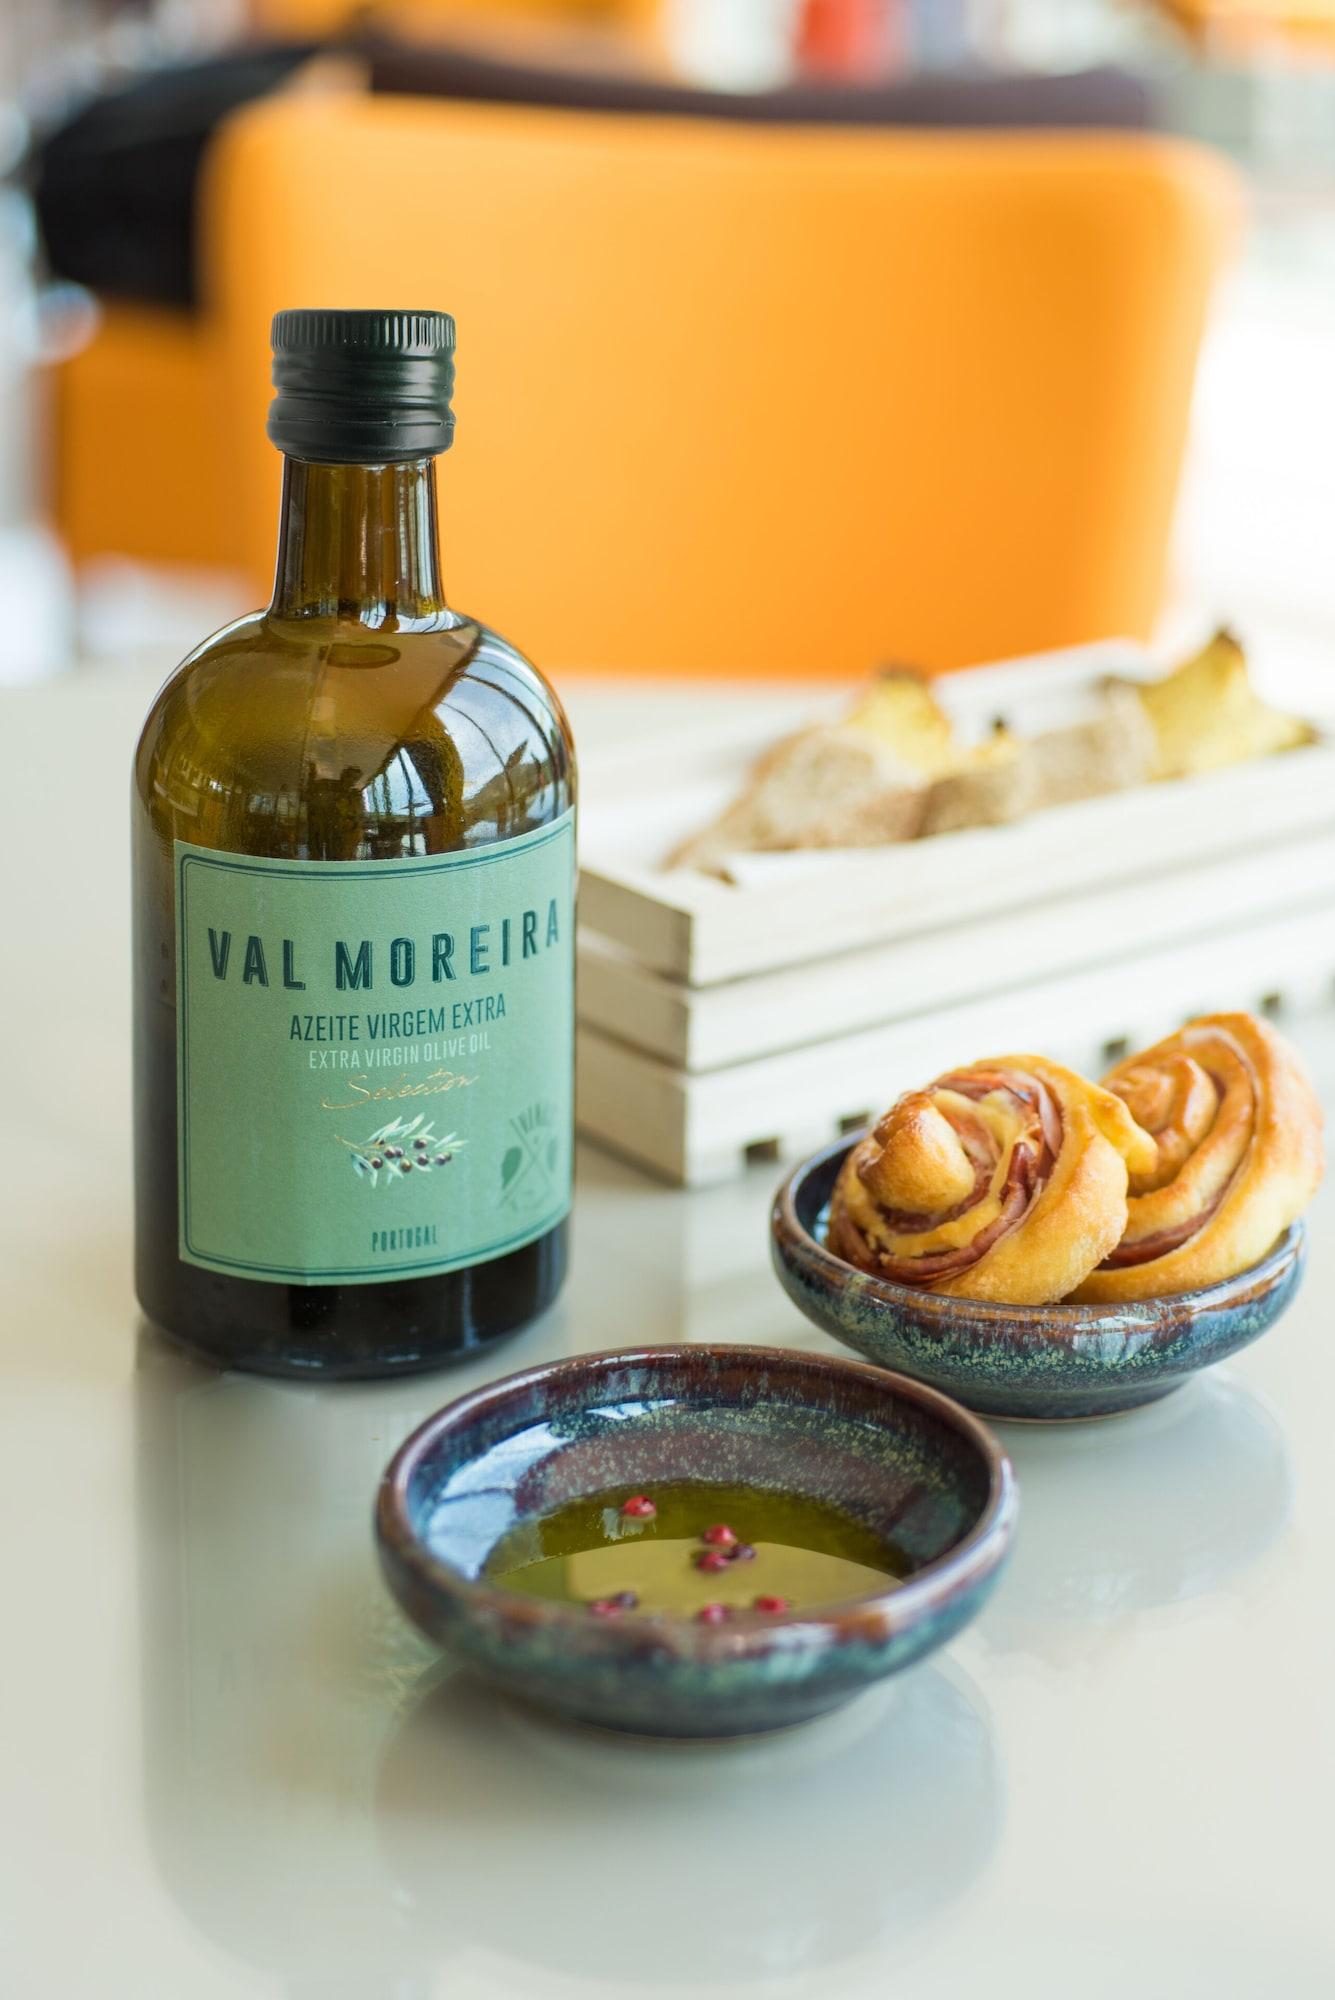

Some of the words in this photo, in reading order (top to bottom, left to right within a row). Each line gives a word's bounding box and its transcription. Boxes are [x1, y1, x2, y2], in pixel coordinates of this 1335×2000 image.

[208, 928, 306, 990] VAL
[336, 899, 558, 990] MOREIRA
[290, 1014, 359, 1041] AZEITE
[367, 1007, 445, 1040] VIRGEM
[452, 993, 506, 1029] EXTRA
[309, 1050, 361, 1069] EXTRA
[365, 1045, 419, 1067] VIRGIN
[423, 1036, 466, 1063] OLIVE
[469, 1031, 492, 1054] OIL
[321, 1067, 480, 1110] Selection
[371, 1225, 438, 1252] PORTUGAL
